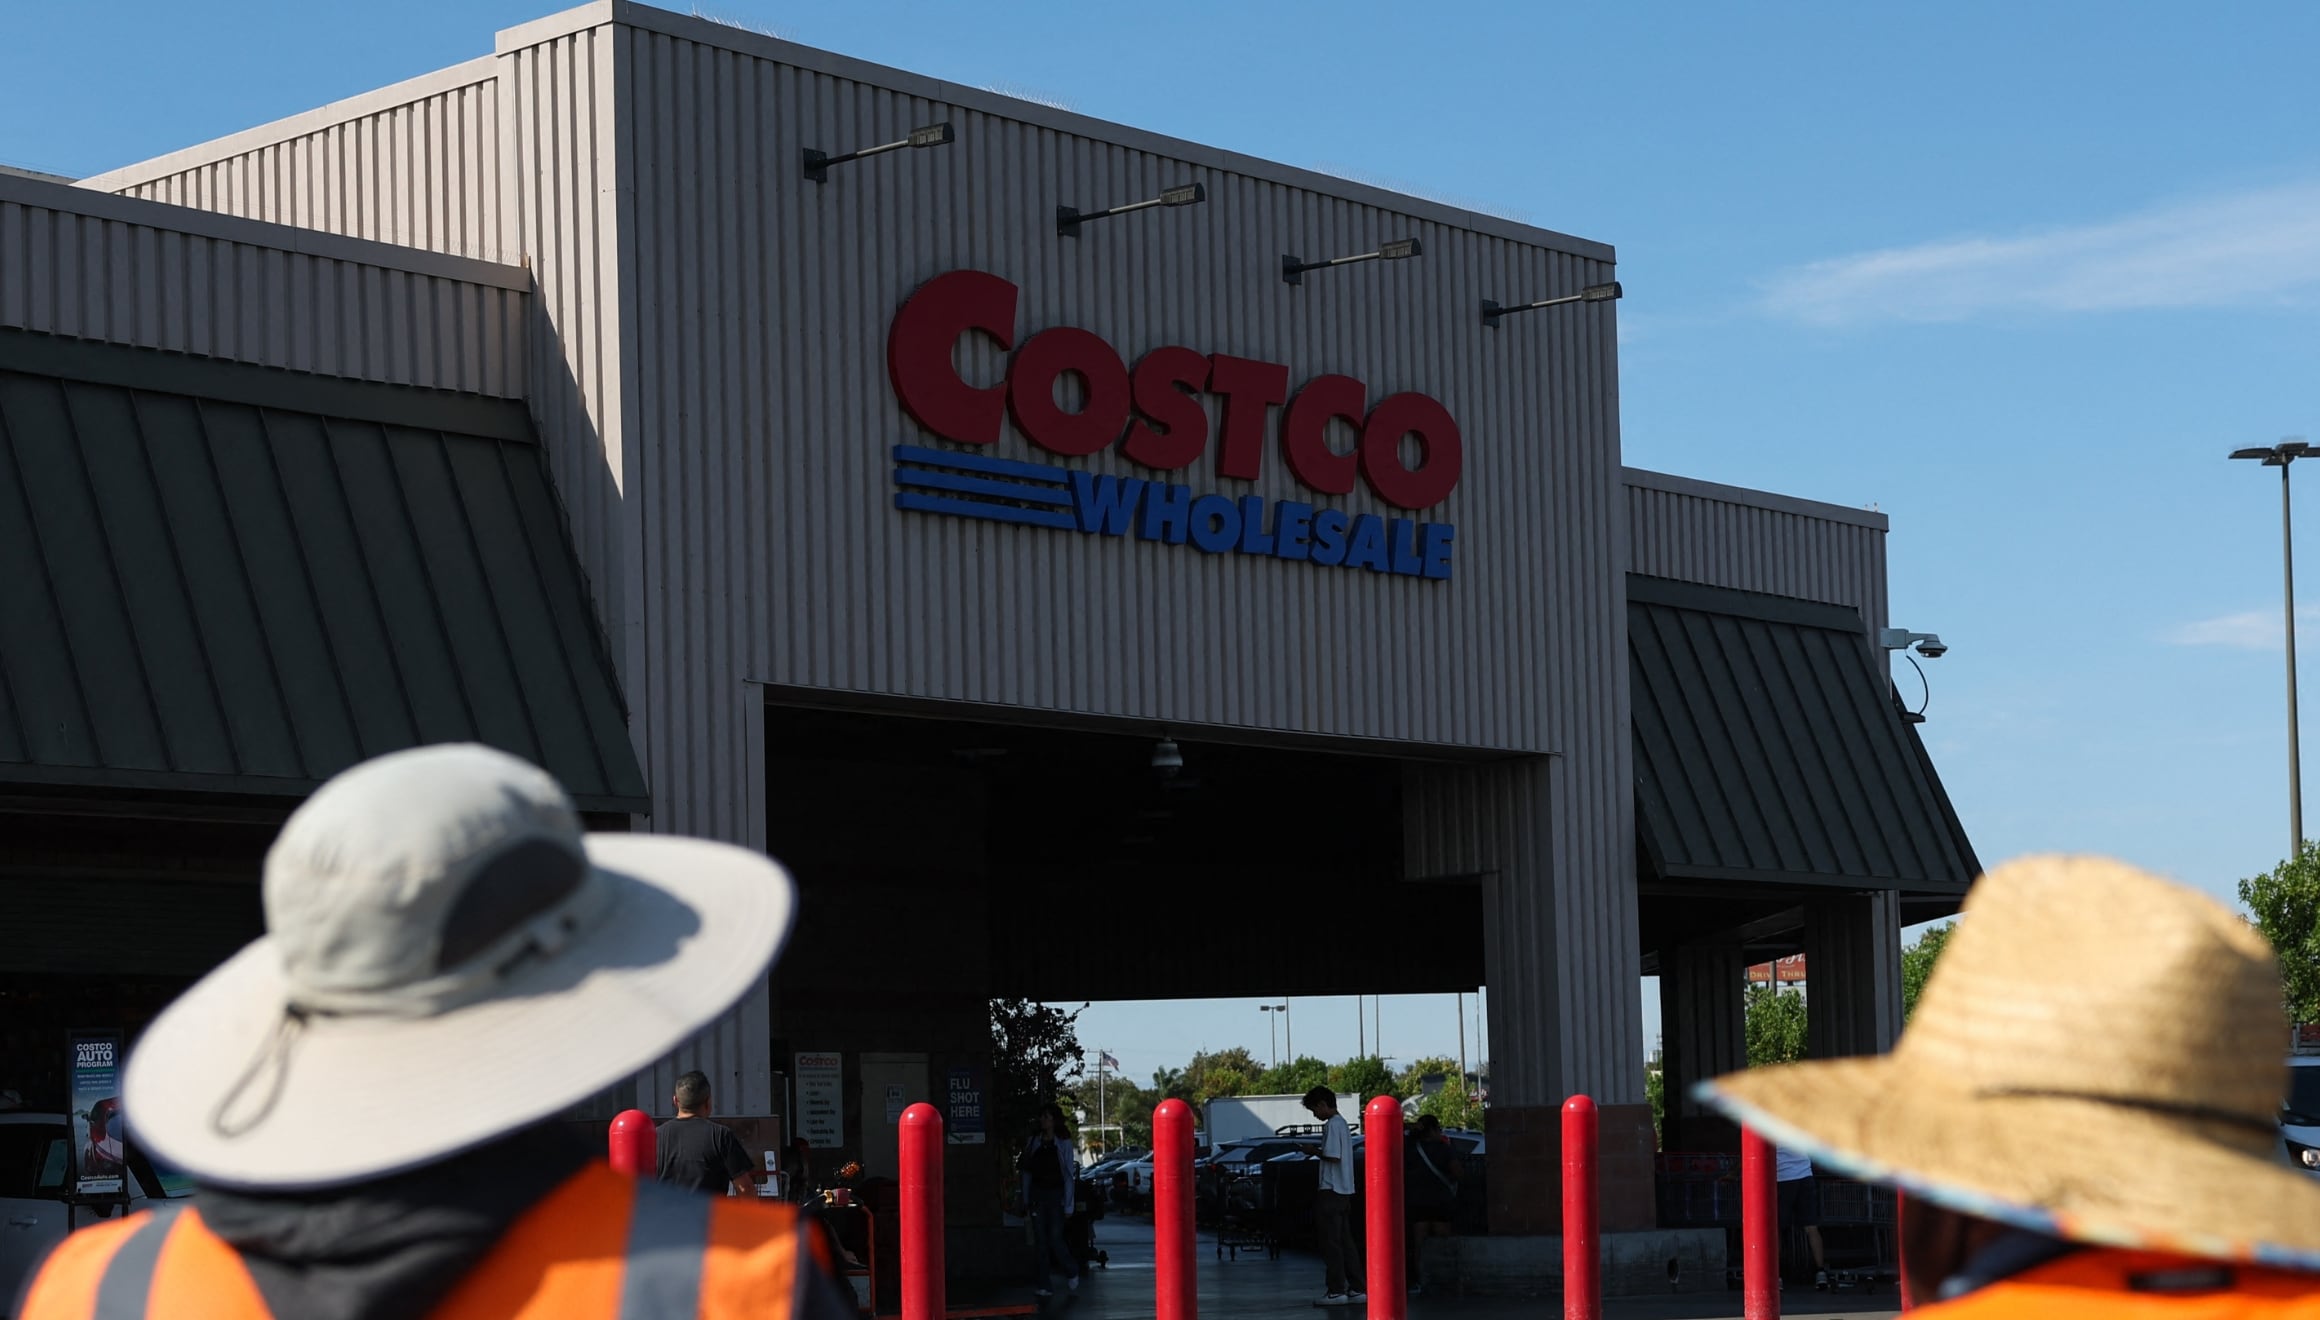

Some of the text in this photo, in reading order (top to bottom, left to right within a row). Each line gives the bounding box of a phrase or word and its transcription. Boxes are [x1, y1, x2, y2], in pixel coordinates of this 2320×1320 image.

[888, 269, 1462, 510] COSTCO
[1067, 470, 1455, 580] WHOLESALE
[76, 1043, 113, 1051] COSTCO
[77, 1050, 113, 1062] AUTO
[799, 1056, 838, 1065] COSTCO
[949, 1078, 970, 1090] FLU
[950, 1092, 980, 1104] SHOT
[951, 1106, 981, 1118] HERE
